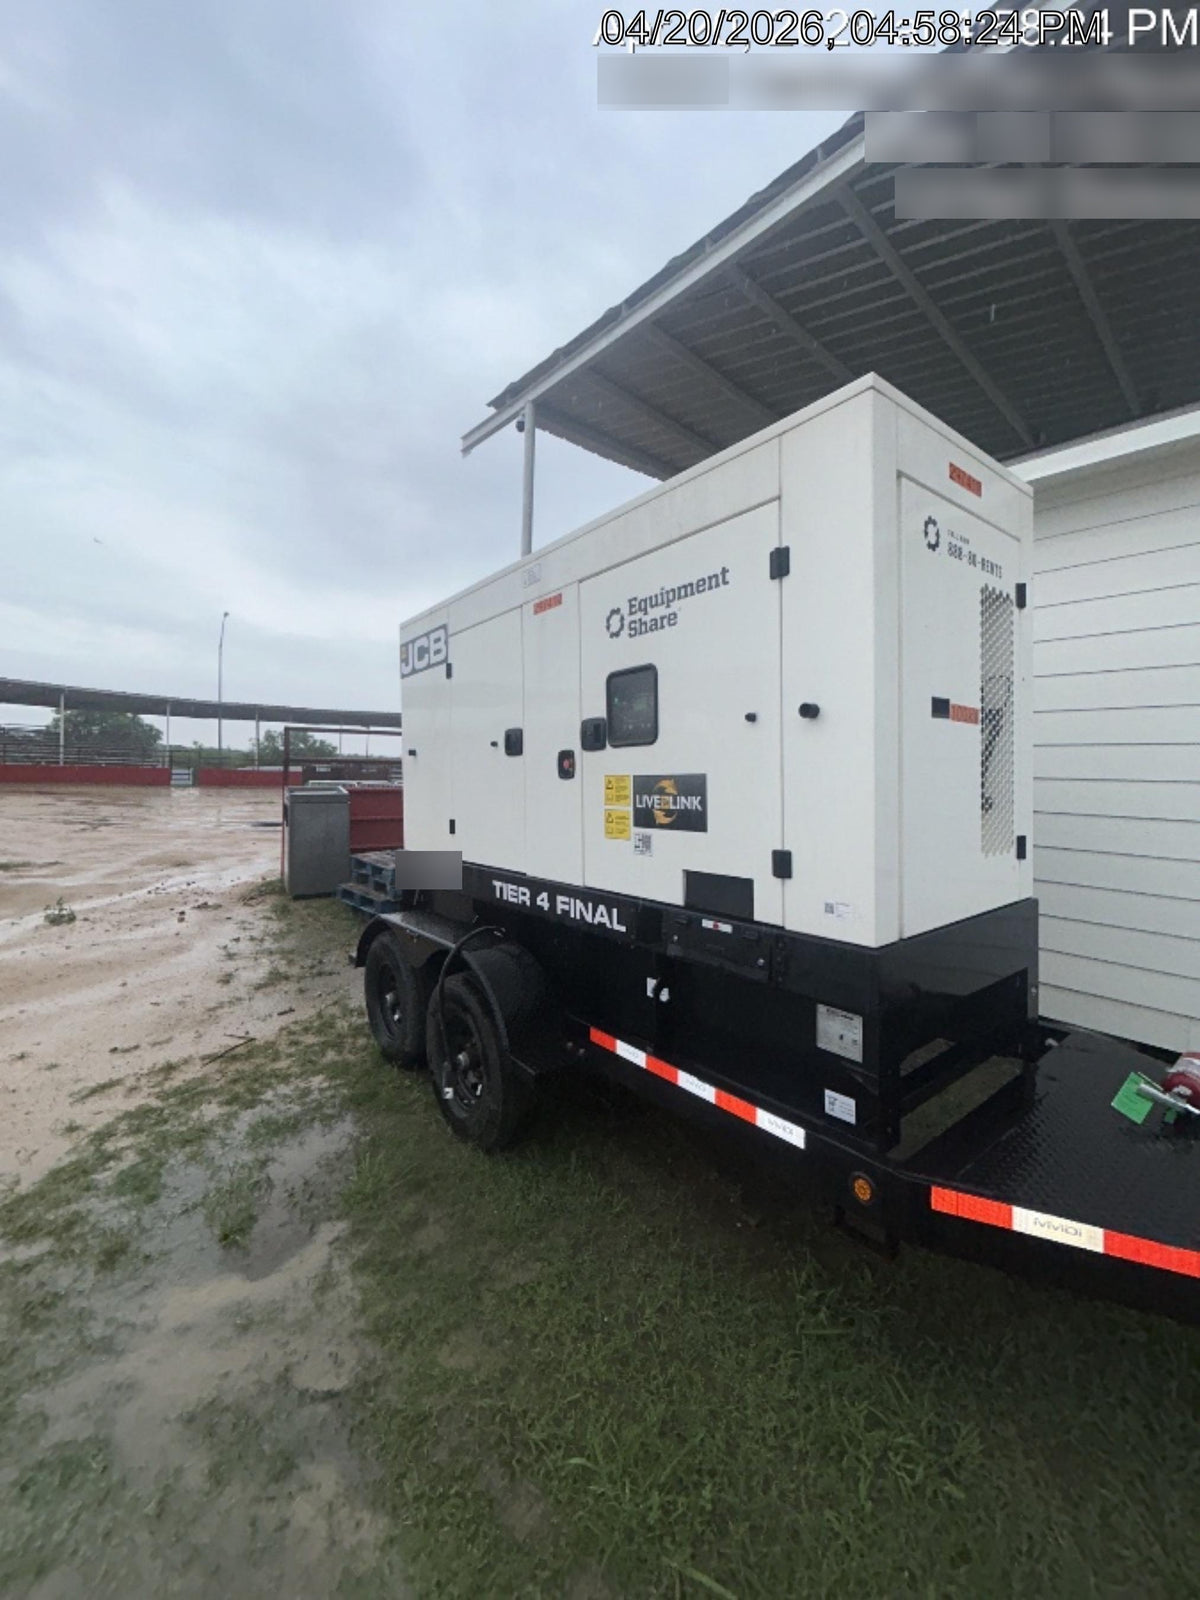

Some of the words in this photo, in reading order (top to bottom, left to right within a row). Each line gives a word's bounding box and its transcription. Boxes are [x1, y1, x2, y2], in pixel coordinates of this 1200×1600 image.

[628, 566, 730, 616] Equipment
[628, 611, 678, 639] Share
[401, 629, 447, 675] JCB
[492, 880, 531, 907] TIER
[536, 892, 550, 911] 4
[556, 894, 627, 933] FINAL
